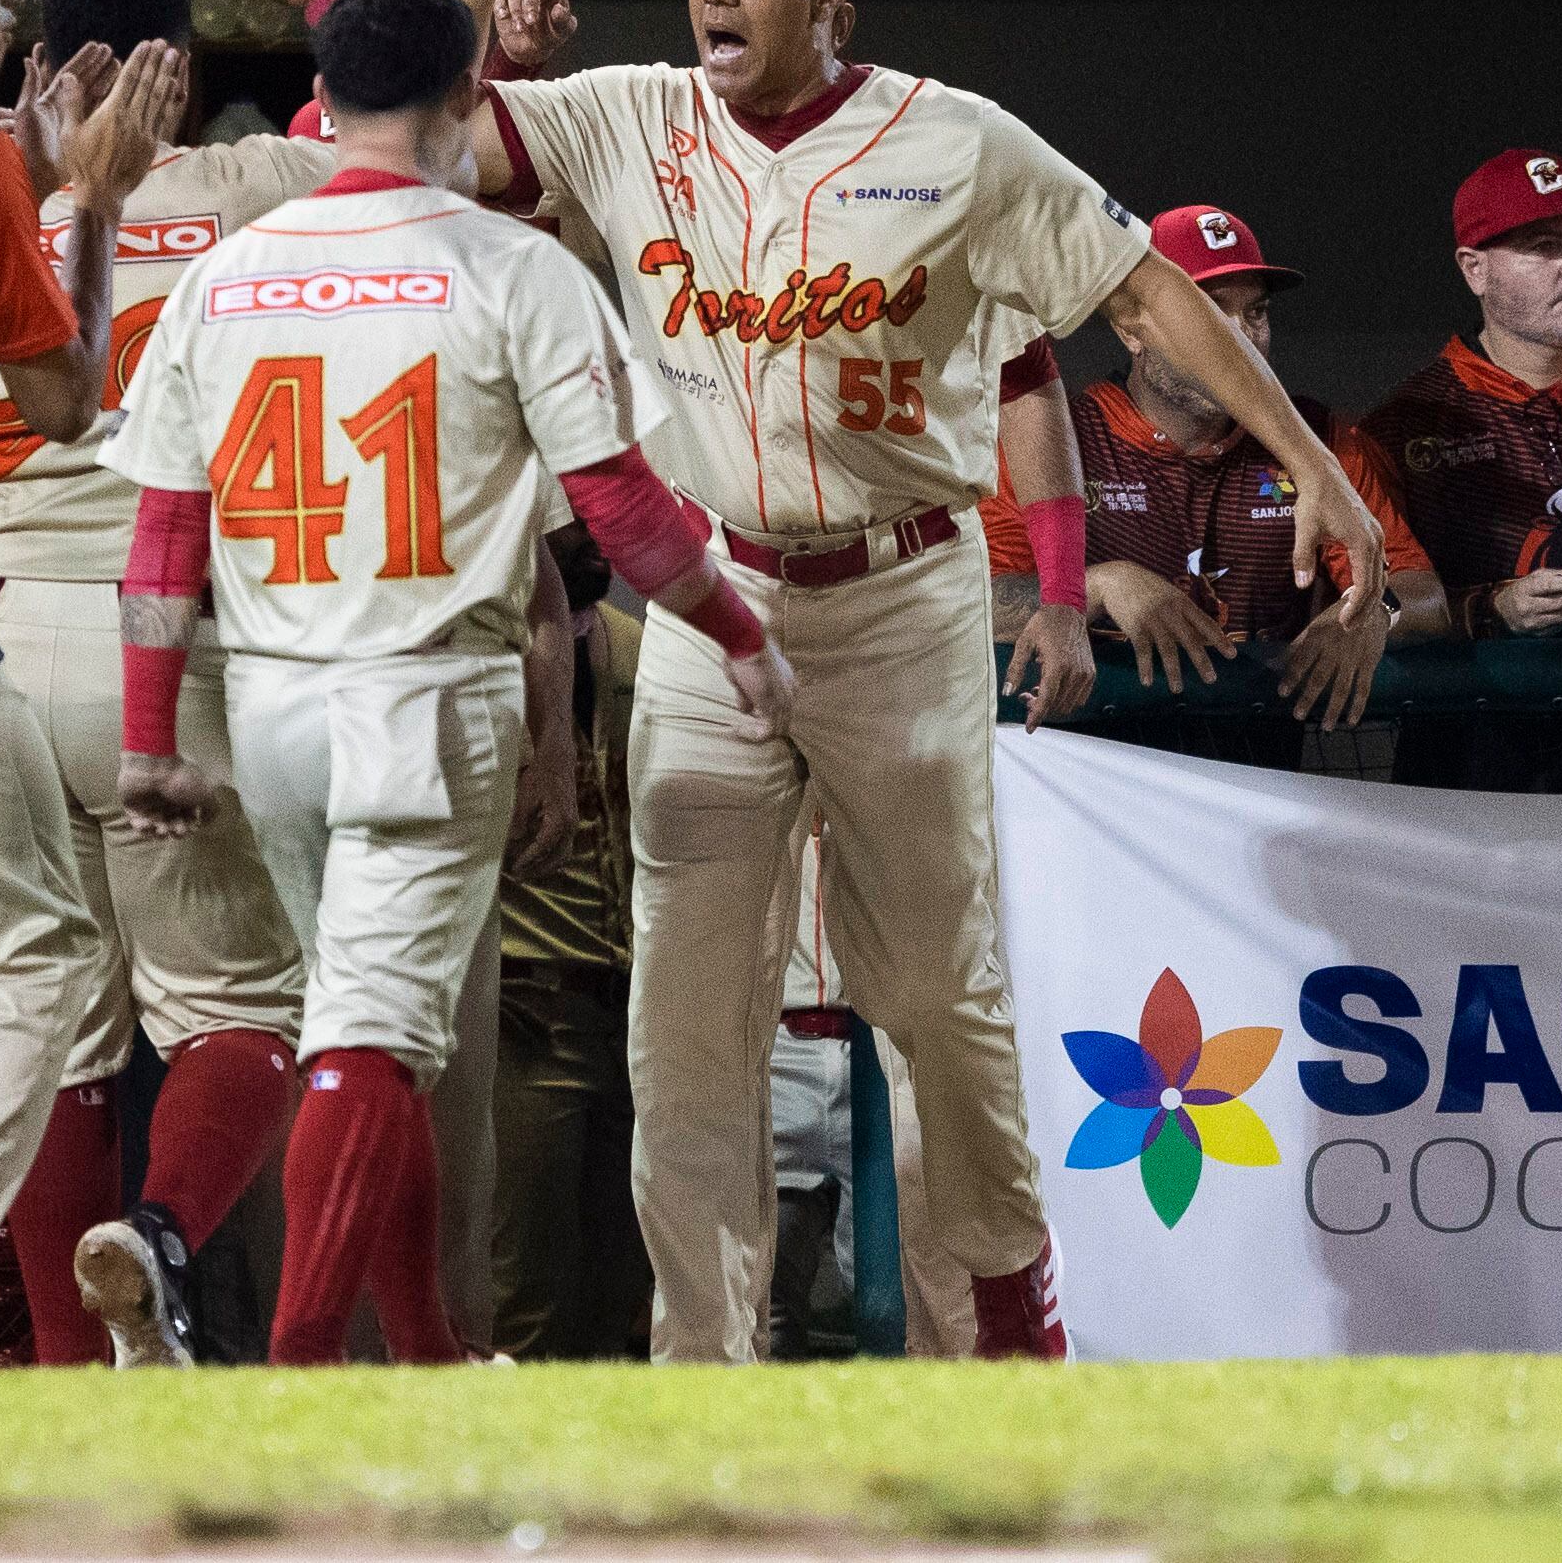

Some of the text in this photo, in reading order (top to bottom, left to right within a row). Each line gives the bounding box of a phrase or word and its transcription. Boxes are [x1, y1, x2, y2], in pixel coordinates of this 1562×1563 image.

[212, 272, 445, 312] ECONO
[638, 238, 927, 344] Toritos
[837, 357, 928, 436] 55
[207, 352, 456, 586] 41
